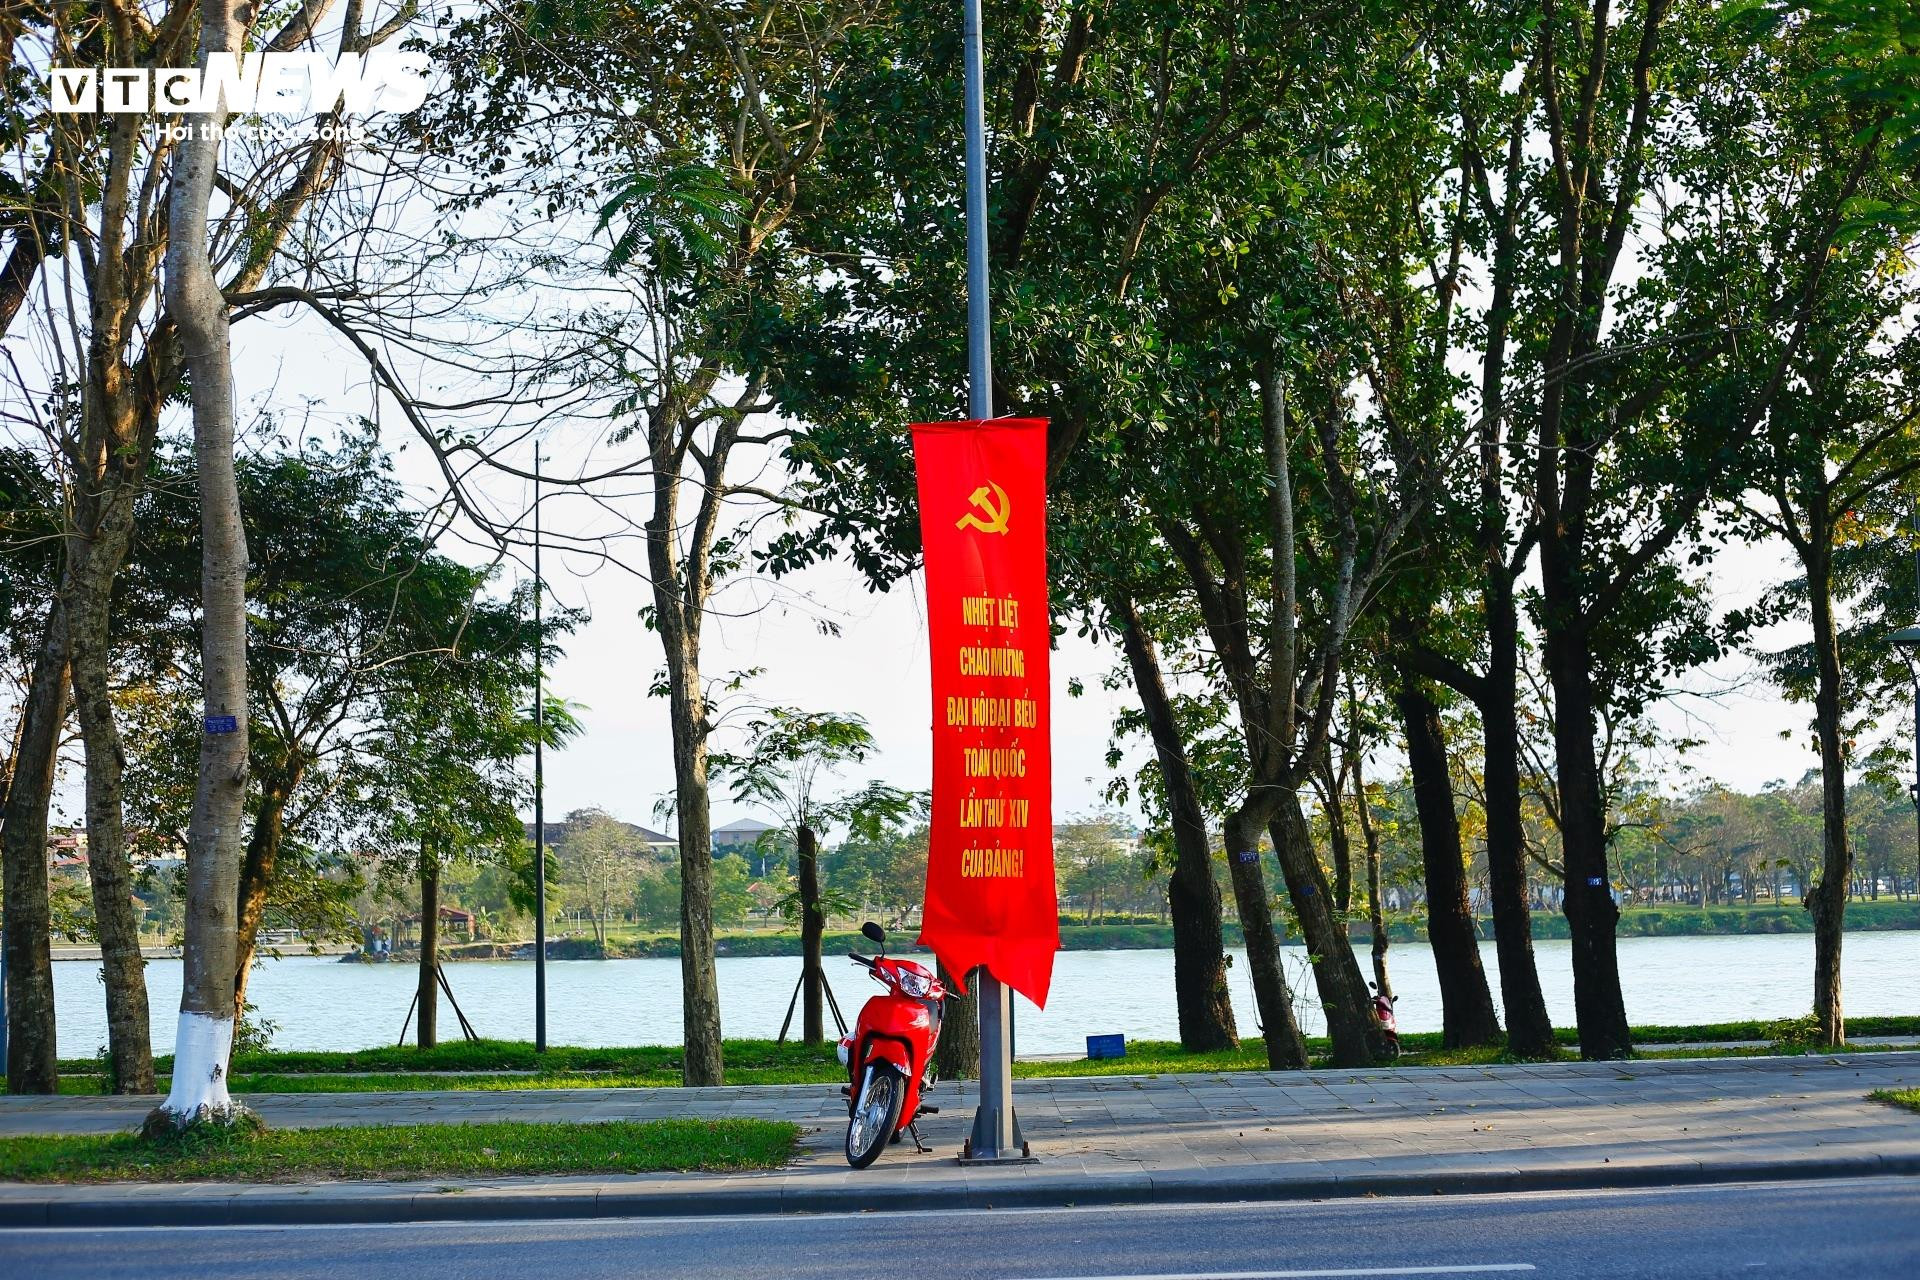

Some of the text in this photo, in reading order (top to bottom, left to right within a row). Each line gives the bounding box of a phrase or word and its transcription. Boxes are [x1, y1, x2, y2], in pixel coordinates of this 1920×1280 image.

[962, 591, 1019, 633] NHIỆT LIỆT
[959, 640, 1025, 678] CHÀO MỪNG
[947, 688, 1037, 733] ĐẠI HỘI ĐẠI BIỂU
[964, 738, 1026, 780] TOÀN QUỐC
[960, 787, 1029, 828] LẦN THỨ XIV
[961, 840, 1024, 878] CỦA ĐẢNG!
